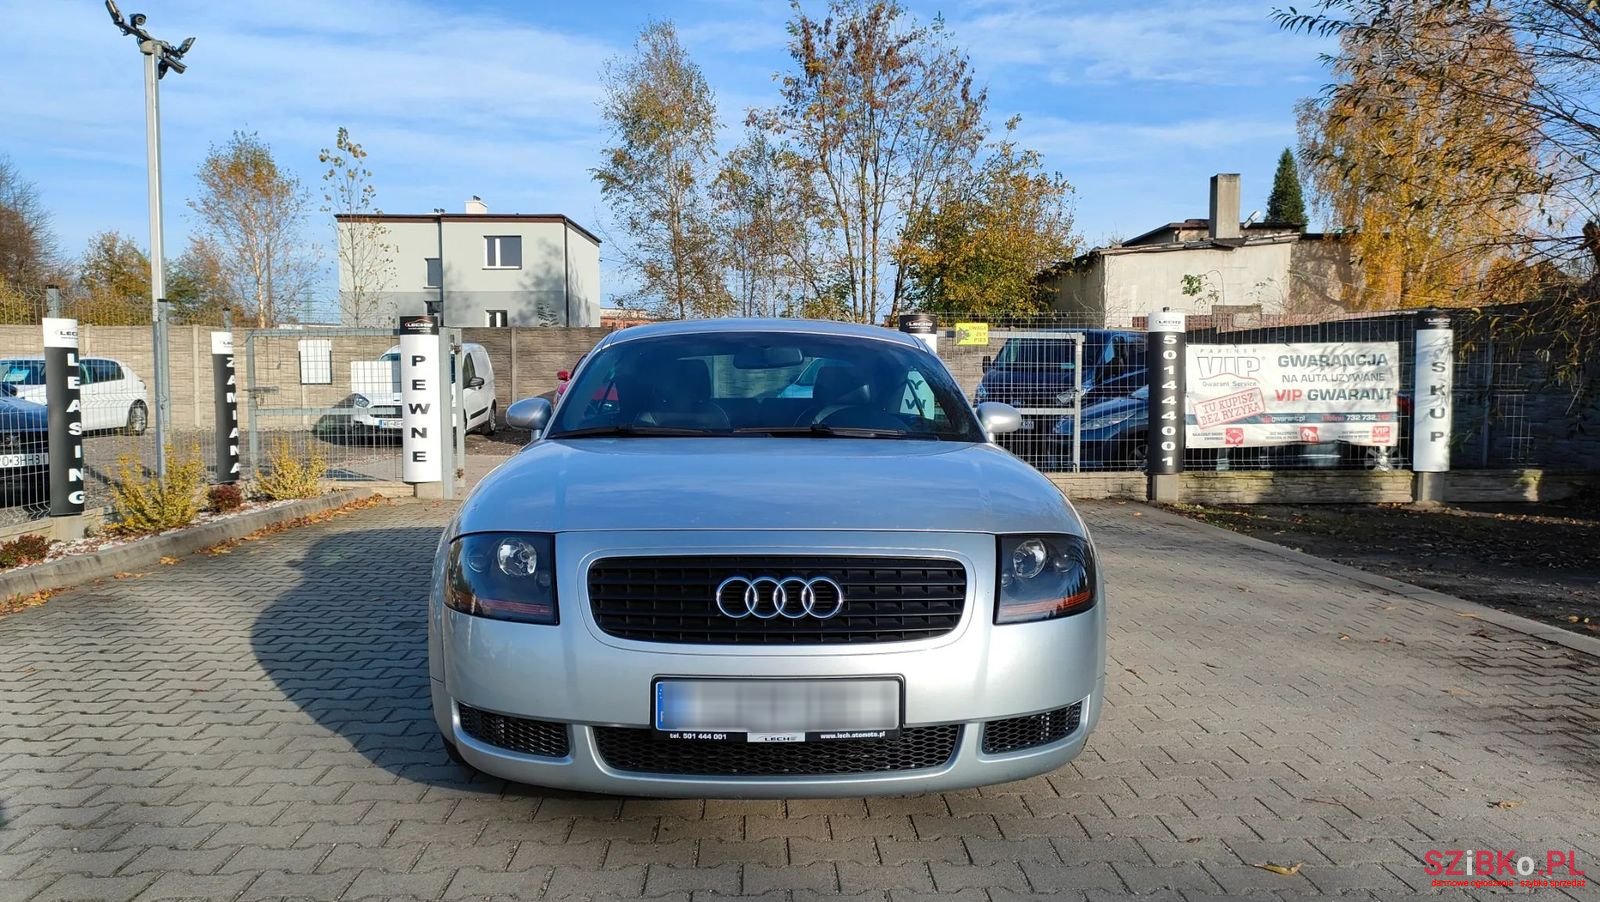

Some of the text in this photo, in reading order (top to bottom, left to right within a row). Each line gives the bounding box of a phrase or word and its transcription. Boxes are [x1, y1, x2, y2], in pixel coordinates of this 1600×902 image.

[1197, 356, 1261, 377] VIP
[1278, 354, 1388, 367] GWARANCJA
[1282, 374, 1298, 382] NA
[1301, 374, 1328, 382] AUTA
[1201, 393, 1255, 414] TU KUPISZ
[1275, 388, 1393, 401] VIP GWARANT
[226, 357, 240, 474] ZAMIANA
[408, 355, 431, 462] PEWNE
[1200, 412, 1221, 425] BEZ
[1221, 403, 1261, 420] RYZYKA
[66, 353, 85, 505] LEASING
